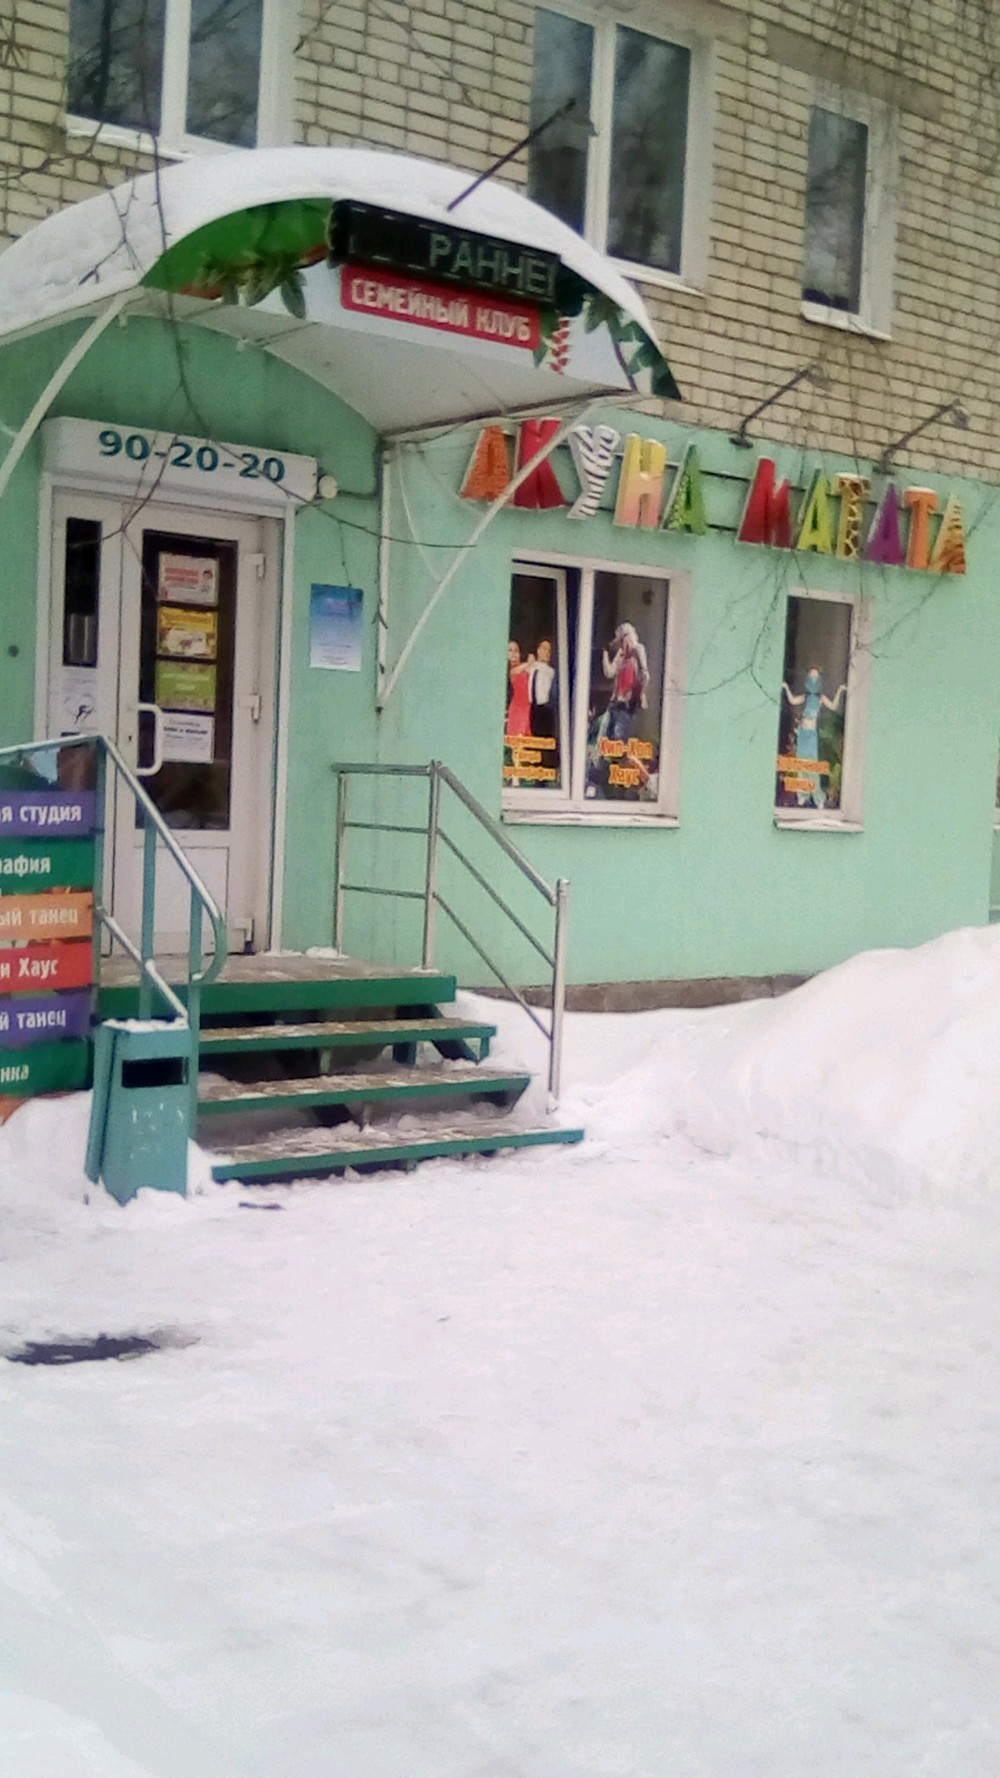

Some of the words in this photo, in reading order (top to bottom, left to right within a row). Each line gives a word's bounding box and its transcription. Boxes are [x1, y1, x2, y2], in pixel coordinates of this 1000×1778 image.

[351, 277, 469, 329] СЕМЕЙНЫЙ
[476, 306, 531, 342] КЛУБ
[98, 430, 285, 483] 90-20-20
[461, 417, 707, 535] АКУНА
[736, 456, 967, 575] МАТАТА
[0, 806, 13, 823] я
[20, 805, 82, 826] студия
[0, 854, 51, 878] афия
[30, 908, 79, 926] танец
[18, 957, 59, 979] Хаус
[16, 1009, 66, 1030] танец
